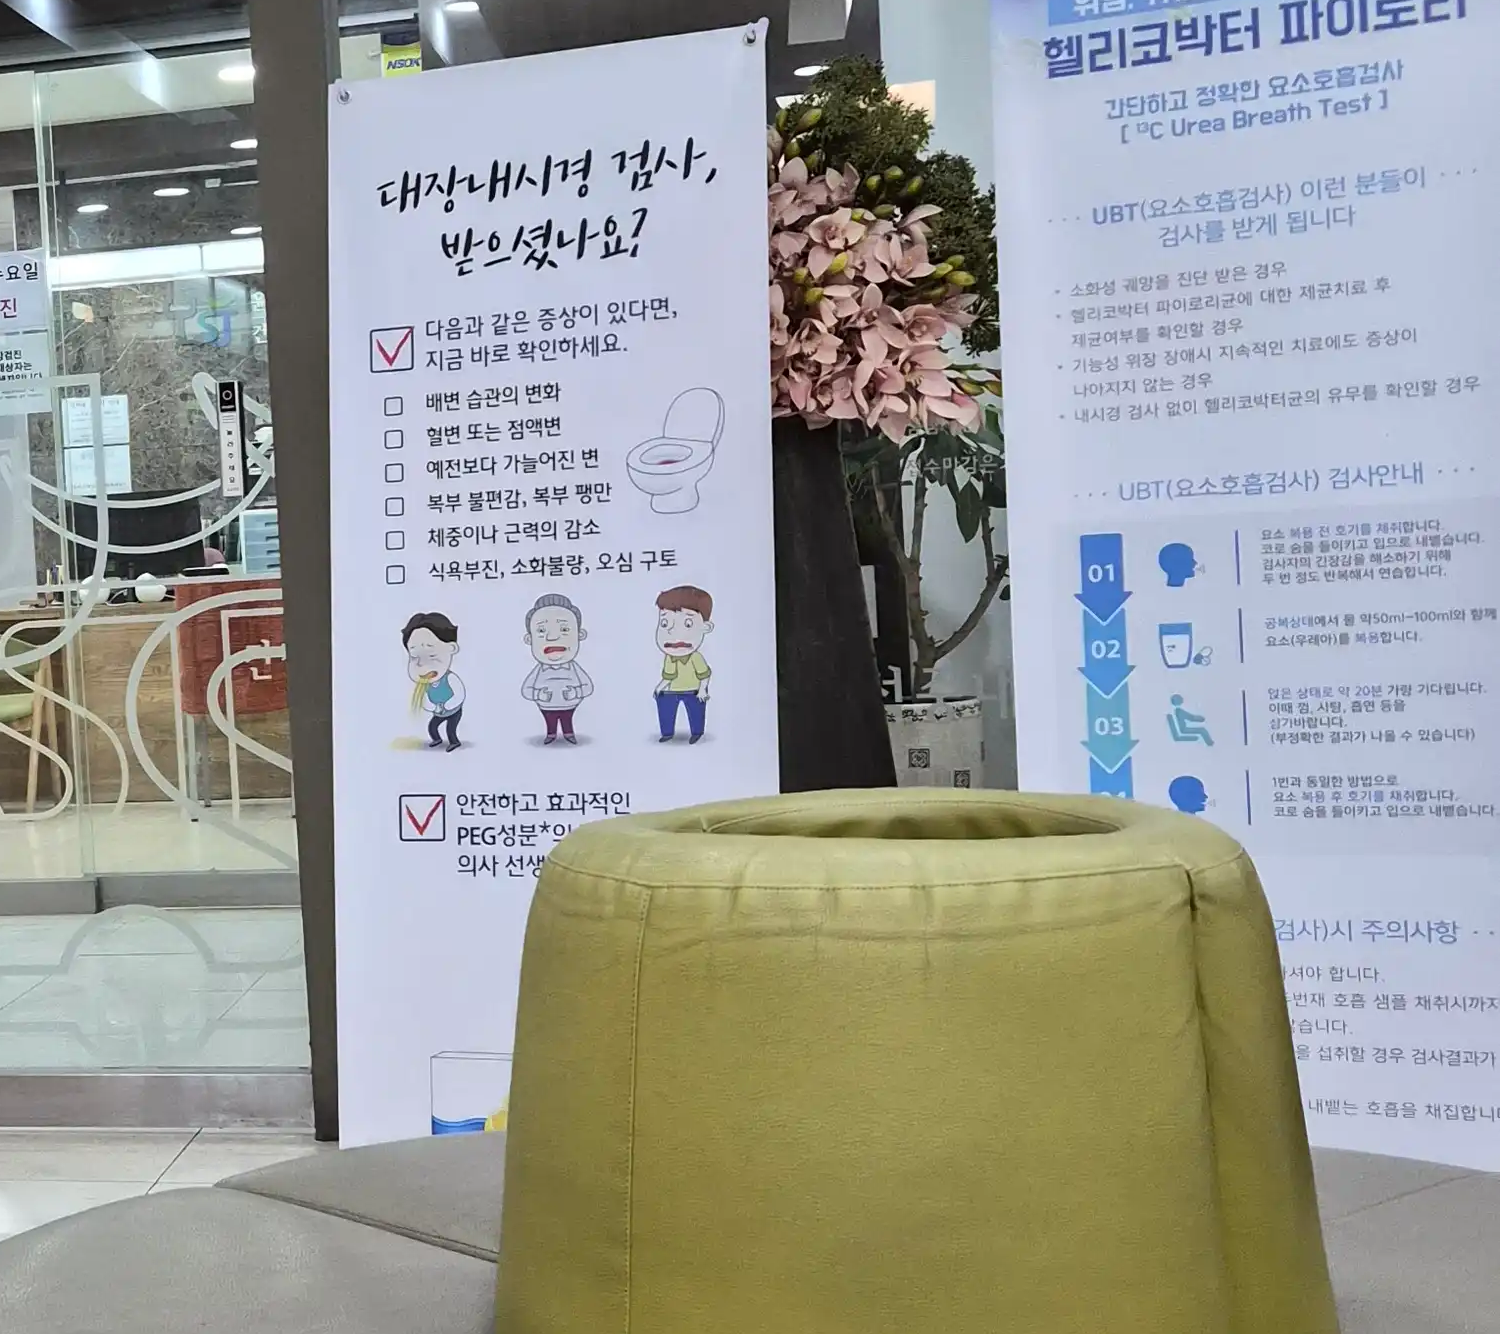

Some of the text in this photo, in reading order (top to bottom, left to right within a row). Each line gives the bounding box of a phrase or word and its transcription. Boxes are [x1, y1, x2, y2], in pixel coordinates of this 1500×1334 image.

[1043, 8, 1261, 79] 헬리코박터
[1104, 60, 1405, 120] 간단하고 정확한 요소호흡검사
[1170, 114, 1226, 137] Urea
[1232, 103, 1312, 131] Breath
[1318, 95, 1373, 119] Test
[376, 137, 718, 214] 대장내시경 검사,
[1092, 166, 1426, 226] UBT(요소호흡검사) 이런 분들이
[440, 207, 648, 277] 받으셨나요?
[1158, 204, 1356, 248] 검사를 받게 됩니다
[1070, 261, 1287, 297] 소화성 궤양을 진단 받은 경우
[1070, 276, 1391, 325] 헬리코박터 파이로리균에 대한 제균치료 후
[425, 296, 678, 342] 다음과 같은 증상이 있다면,
[1071, 317, 1244, 349] 제균여부를 확인할 경우
[425, 333, 628, 371] 지금 바로 확인하세요.
[1073, 327, 1418, 374] 기능성 위장 장애시 지속적인 치료에도 증상이
[426, 381, 562, 413] 배변 습관의 변화
[1073, 372, 1214, 398] 나아지지 않는 경우
[1074, 375, 1481, 423] 내시경 검사 없이 헬리코박터균의 유무를 확인할 경우
[426, 416, 562, 448] 혈변 또는 점액변
[426, 447, 599, 480] 예전보다 가늘어진 변
[1118, 461, 1424, 501] UBT(요소호흡검사) 검사안내
[427, 482, 613, 514] 복부 불편감, 복부 팽만
[427, 518, 601, 548] 체중이나 근력의 감소
[428, 549, 678, 583] 식욕부진, 소화불량, 오심 구토
[1087, 563, 1117, 583] 01
[1090, 640, 1122, 660] 02
[1094, 716, 1125, 736] 03
[456, 792, 631, 816] 안전하고 효과적인
[457, 854, 499, 876] 의사
[1361, 919, 1461, 945] 주의사항
[1328, 965, 1385, 984] 합니다.
[1333, 993, 1367, 1009] 호흡
[1373, 993, 1408, 1011] 샘플
[1291, 1018, 1354, 1035] 습니다.
[1316, 1045, 1366, 1063] 섭취할
[1371, 1047, 1406, 1064] 경우
[1411, 1048, 1497, 1068] 검사결과가
